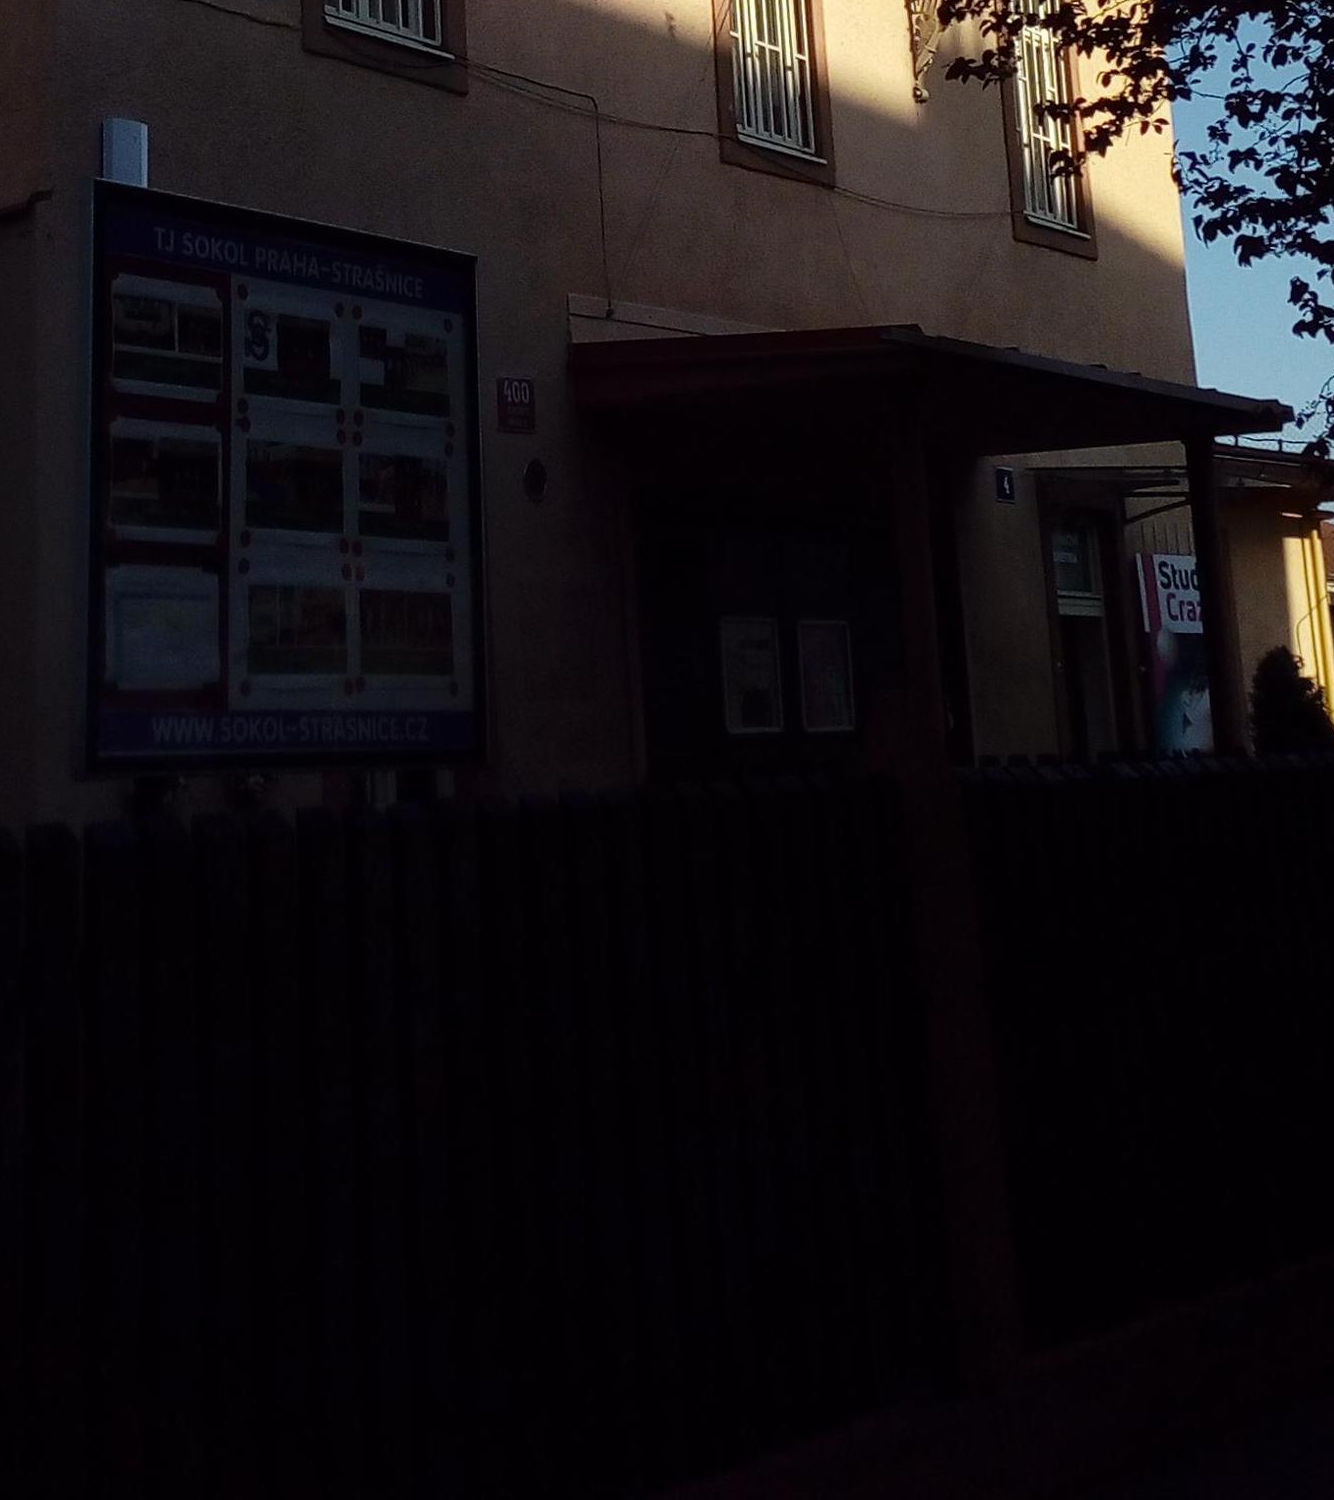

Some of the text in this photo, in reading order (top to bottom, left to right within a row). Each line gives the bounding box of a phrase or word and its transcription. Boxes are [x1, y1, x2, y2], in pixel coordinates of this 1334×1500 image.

[153, 226, 176, 252] TJ
[182, 230, 249, 267] SOKOL
[503, 378, 530, 405] 400
